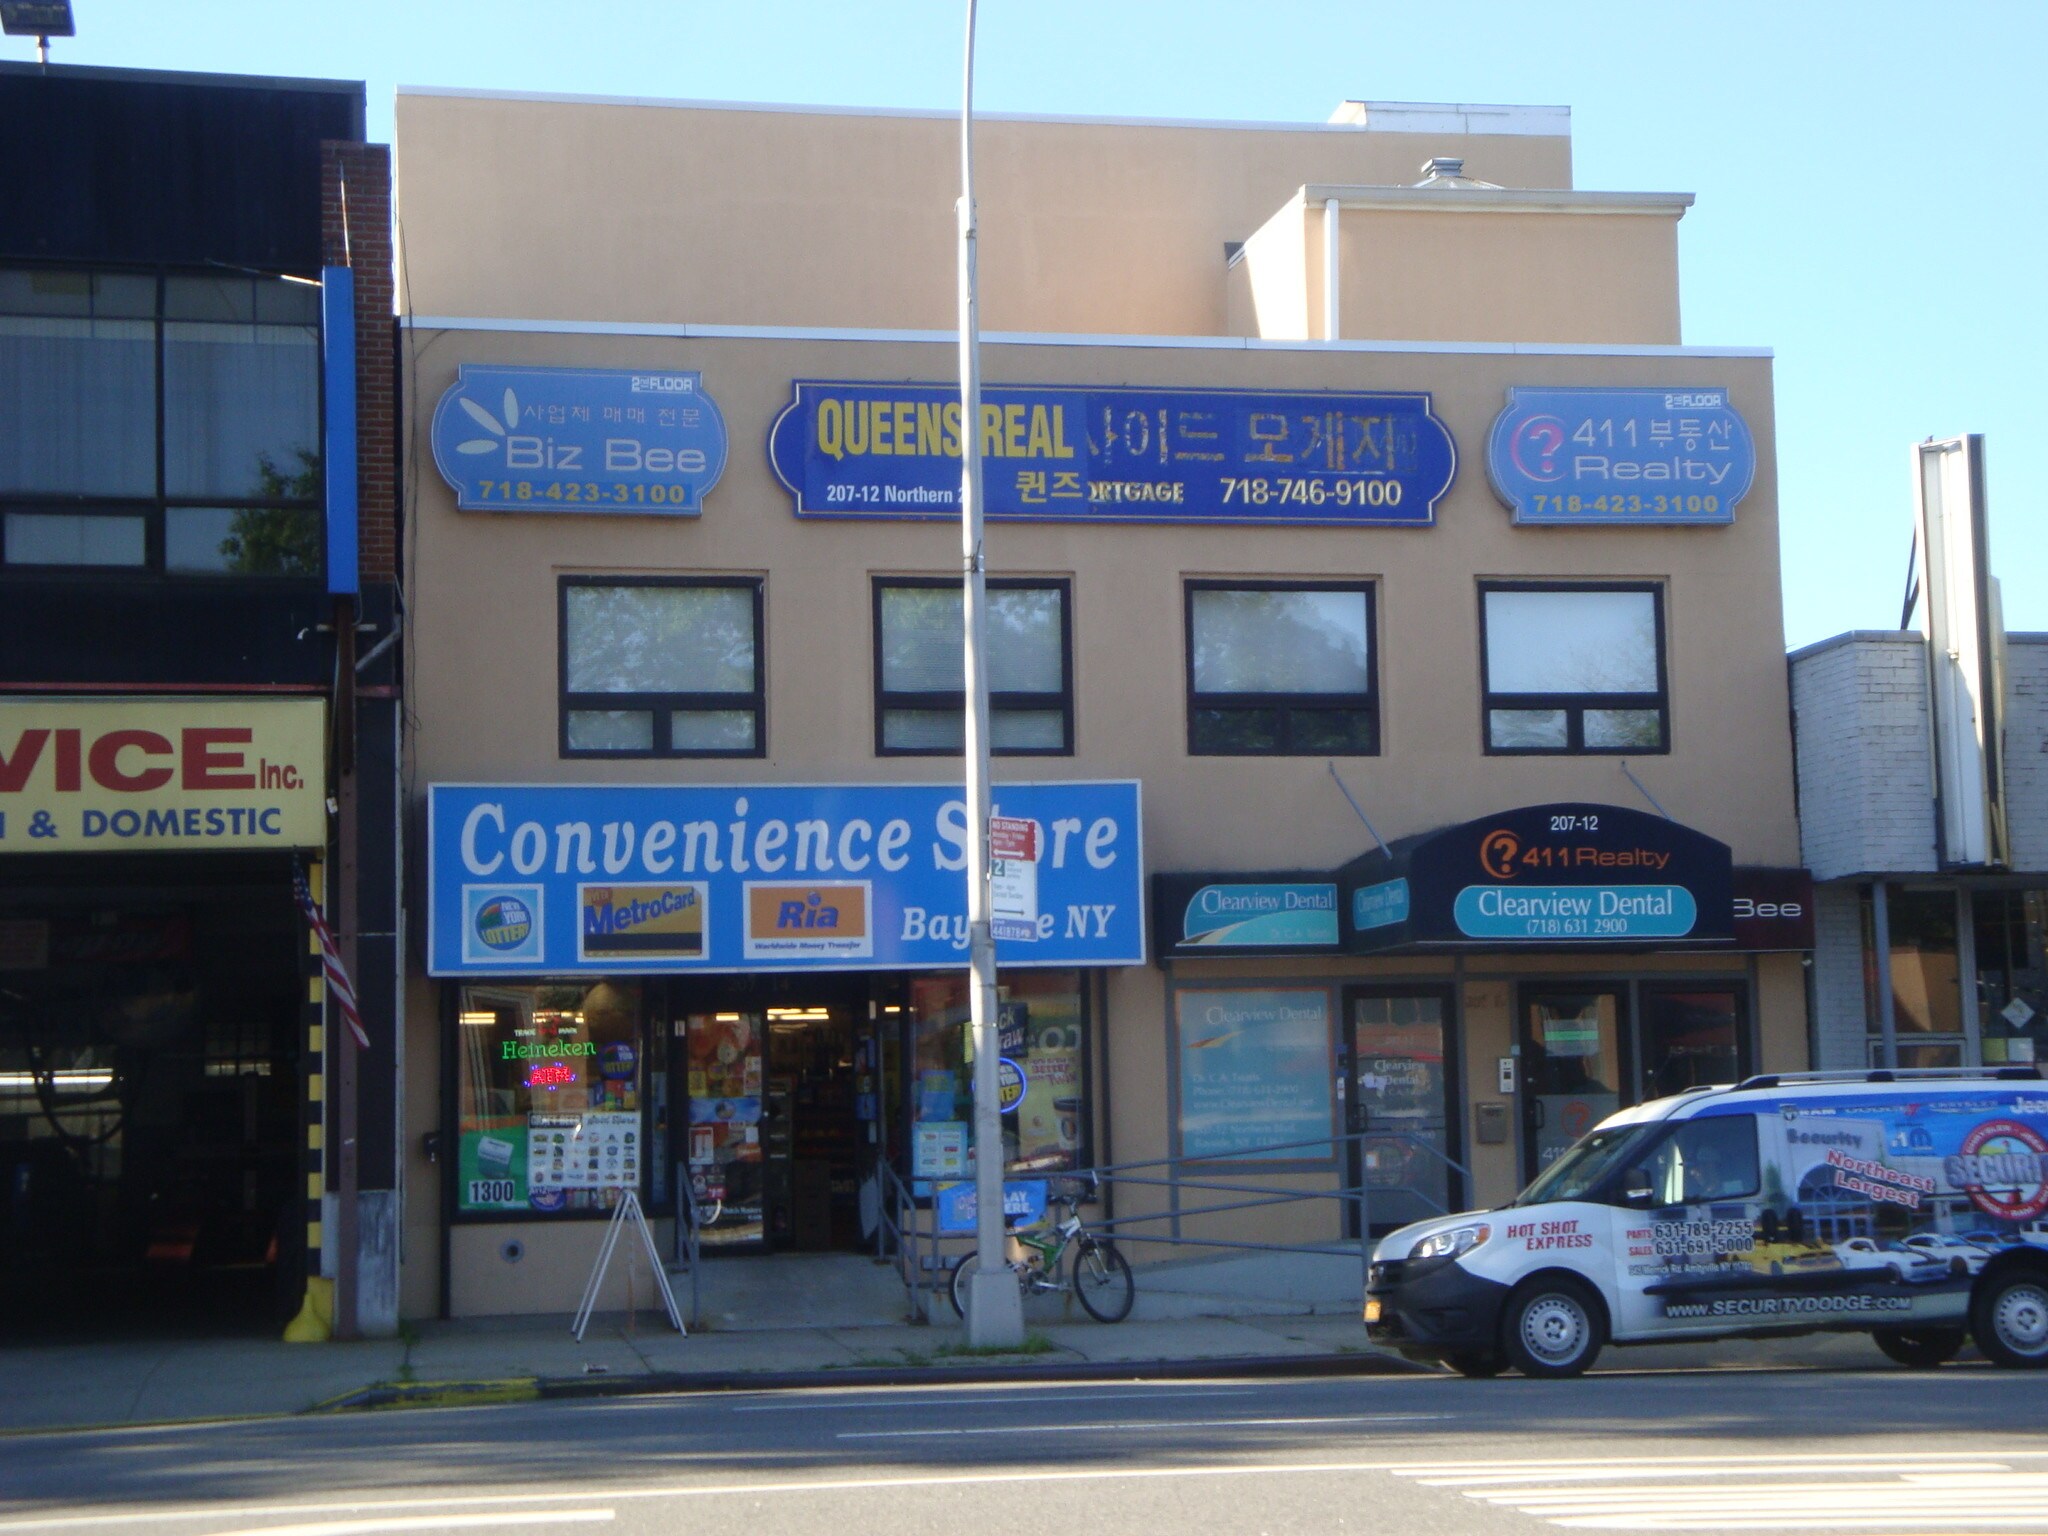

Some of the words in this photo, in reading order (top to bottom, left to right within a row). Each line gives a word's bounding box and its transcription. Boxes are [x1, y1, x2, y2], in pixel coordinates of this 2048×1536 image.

[650, 377, 692, 391] FLOOR
[1683, 394, 1721, 407] FLOOR
[818, 398, 962, 462] QUEENS
[979, 404, 1074, 458] REAL
[1572, 418, 1637, 448] 411
[1650, 418, 1733, 451] 부동산
[506, 435, 583, 469] Biz
[605, 438, 706, 473] Bee
[1574, 456, 1732, 485] Realty
[479, 481, 685, 503] 718-423-3100
[826, 484, 880, 503] 207-12
[885, 486, 953, 503] Northern
[1016, 471, 1082, 503] 퀸즈
[1220, 477, 1402, 505] 718-746-9100
[1533, 495, 1719, 513] 718-423-3100
[260, 758, 304, 789] Inc.
[28, 810, 57, 838] &
[83, 807, 281, 838] DOMESTIC
[1550, 815, 1599, 831] 207-12
[461, 797, 911, 876] Convenience
[933, 800, 1118, 870] Sre
[995, 860, 1003, 875] 2
[1522, 847, 1569, 867] 411
[1576, 848, 1670, 869] Realty
[584, 890, 695, 934] MetroCard
[777, 891, 839, 928] Ria
[1202, 889, 1280, 914] Clearview
[1285, 890, 1333, 909] Dental
[1479, 890, 1592, 918] Clearview
[1599, 889, 1673, 916] Dental
[902, 906, 1053, 950] Baye
[1065, 905, 1117, 939] NY
[1527, 918, 1560, 935] (718)
[1564, 919, 1588, 933] 631
[1594, 918, 1628, 933] 2900
[1207, 1006, 1277, 1025] Clearview
[1280, 1005, 1323, 1021] Dental
[501, 1038, 597, 1060] Heineken
[998, 1028, 1025, 1050] raw
[531, 1066, 572, 1087] ATM
[1374, 1058, 1427, 1073] Clearview
[1386, 1074, 1419, 1086] Dental
[1787, 1128, 1862, 1148] Security
[1826, 1149, 1935, 1193] Northeast
[471, 1181, 514, 1202] 1300
[1004, 1191, 1028, 1203] LAY
[1834, 1170, 1920, 1209] Largest
[1004, 1203, 1035, 1214] ERE.
[1507, 1223, 1537, 1239] HOT
[1541, 1220, 1579, 1236] SHOT
[1626, 1229, 1652, 1239] PARTS
[1655, 1220, 1754, 1239] 631-789-2255
[1527, 1234, 1593, 1250] EXPRESS
[1629, 1246, 1652, 1257] SALES
[1655, 1238, 1754, 1256] 631-691-5000
